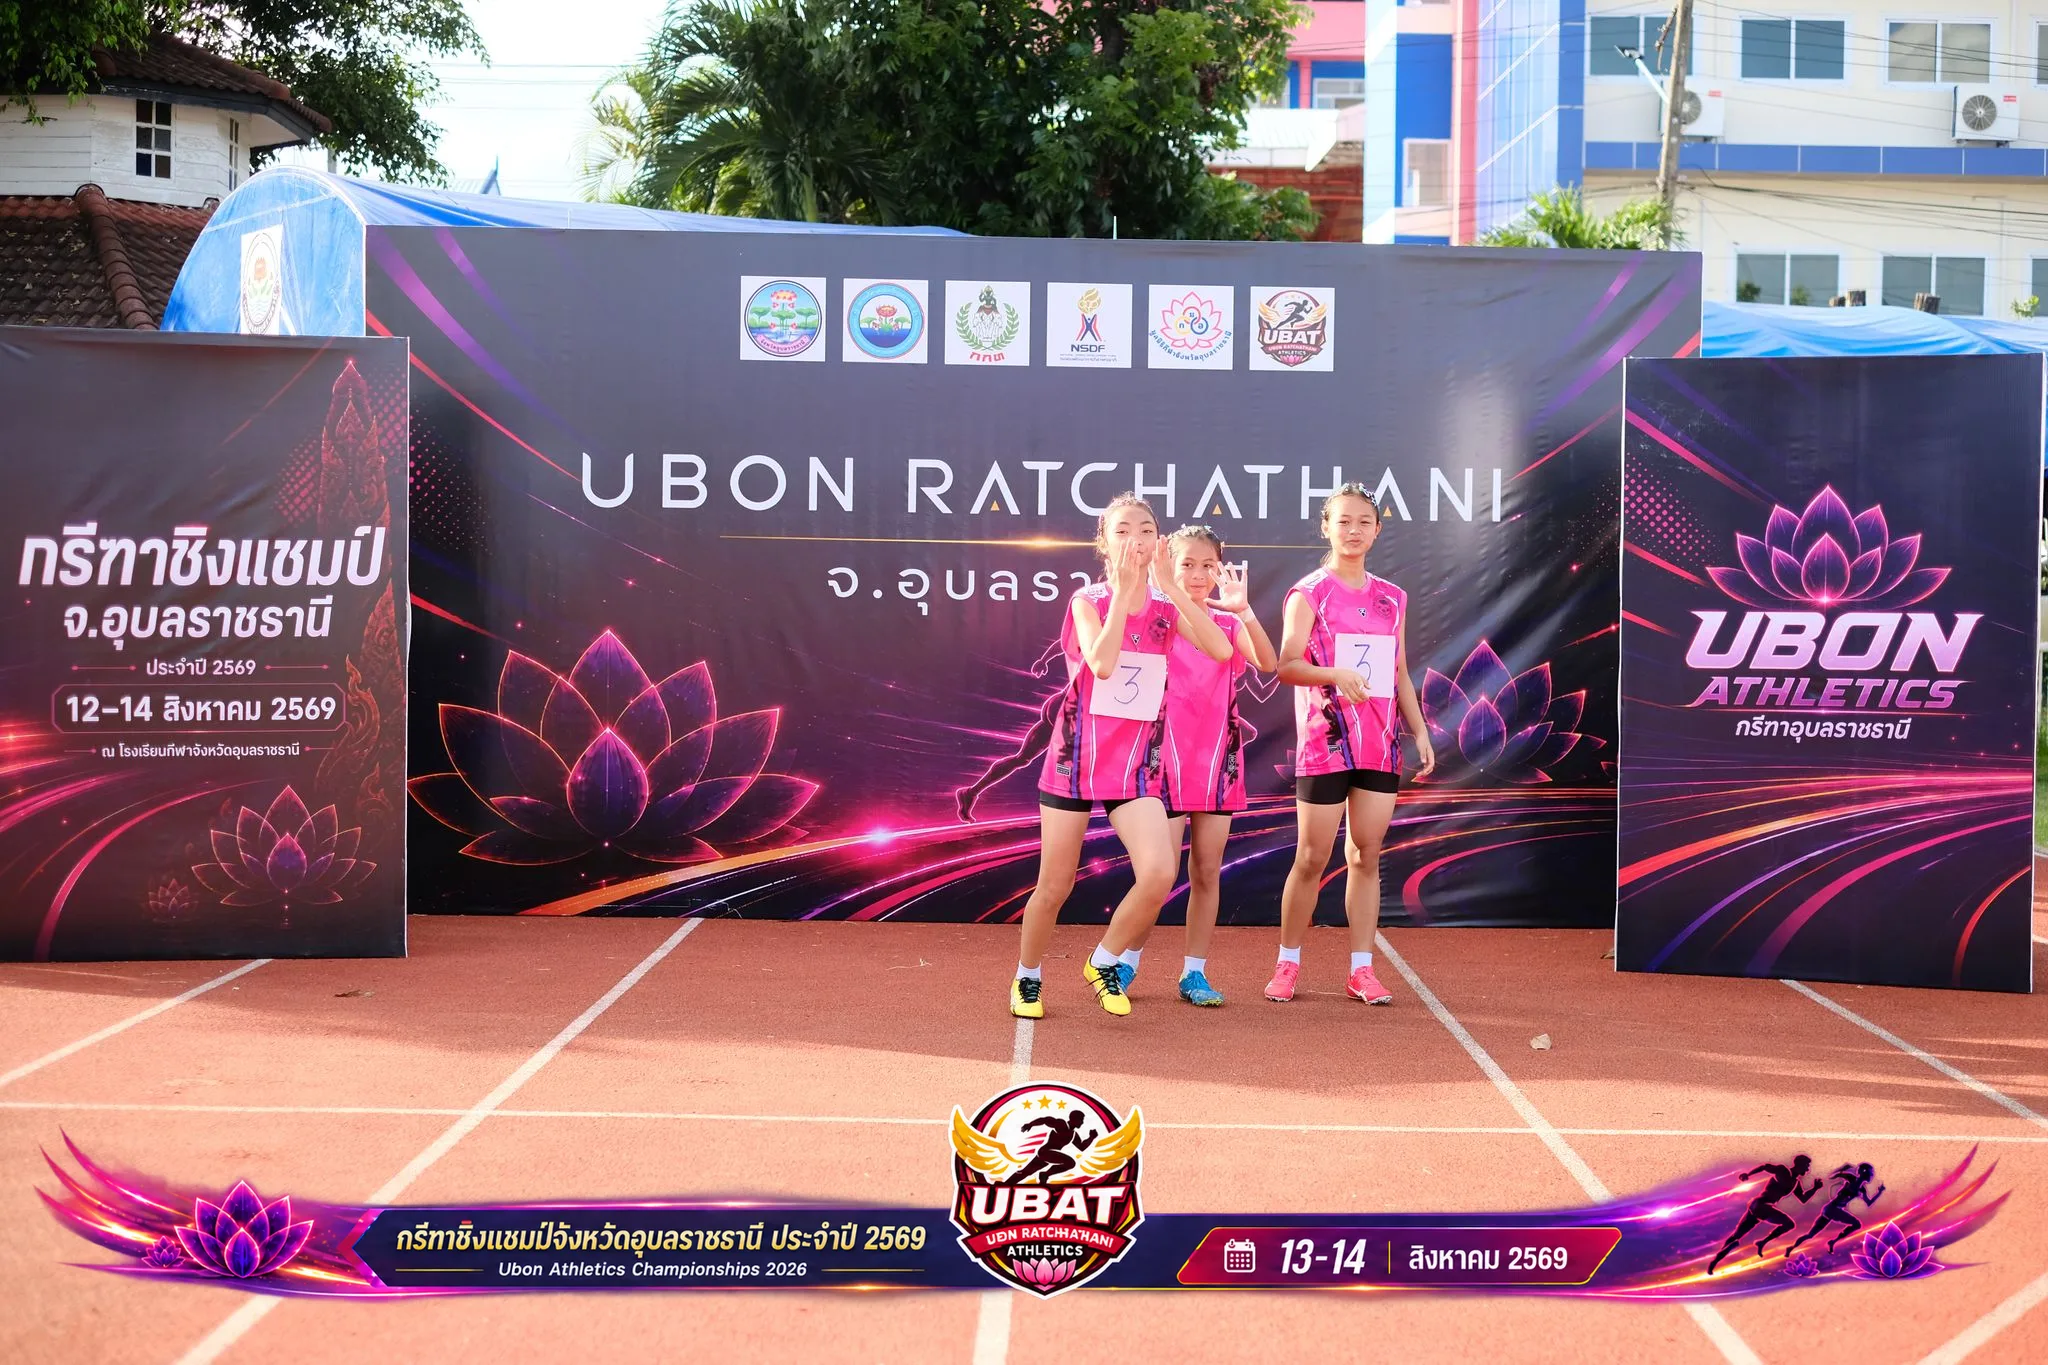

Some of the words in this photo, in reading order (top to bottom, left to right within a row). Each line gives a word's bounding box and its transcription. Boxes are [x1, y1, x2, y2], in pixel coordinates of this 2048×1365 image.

[1071, 344, 1105, 352] NSDF
[1263, 329, 1321, 345] UBAT
[582, 452, 854, 512] UBON
[18, 522, 386, 587] กรีฑาชิงแชมป์
[63, 595, 334, 651] จ.อุบลราชธานี
[1685, 610, 1985, 673] UBON
[146, 657, 207, 676] ประจำปี
[212, 659, 256, 676] 2569
[1354, 643, 1372, 681] 3
[1114, 665, 1142, 705] 3
[1687, 676, 1972, 709] ATHLETICS
[162, 694, 262, 722] สิงหาคม
[271, 695, 337, 721] 2569
[1735, 714, 1912, 744] กรีฑาอุบลราชธานี
[101, 746, 115, 758] ณ
[118, 742, 300, 760] โรงเรียนกีฬาจังหวัดอุบลราชธานี
